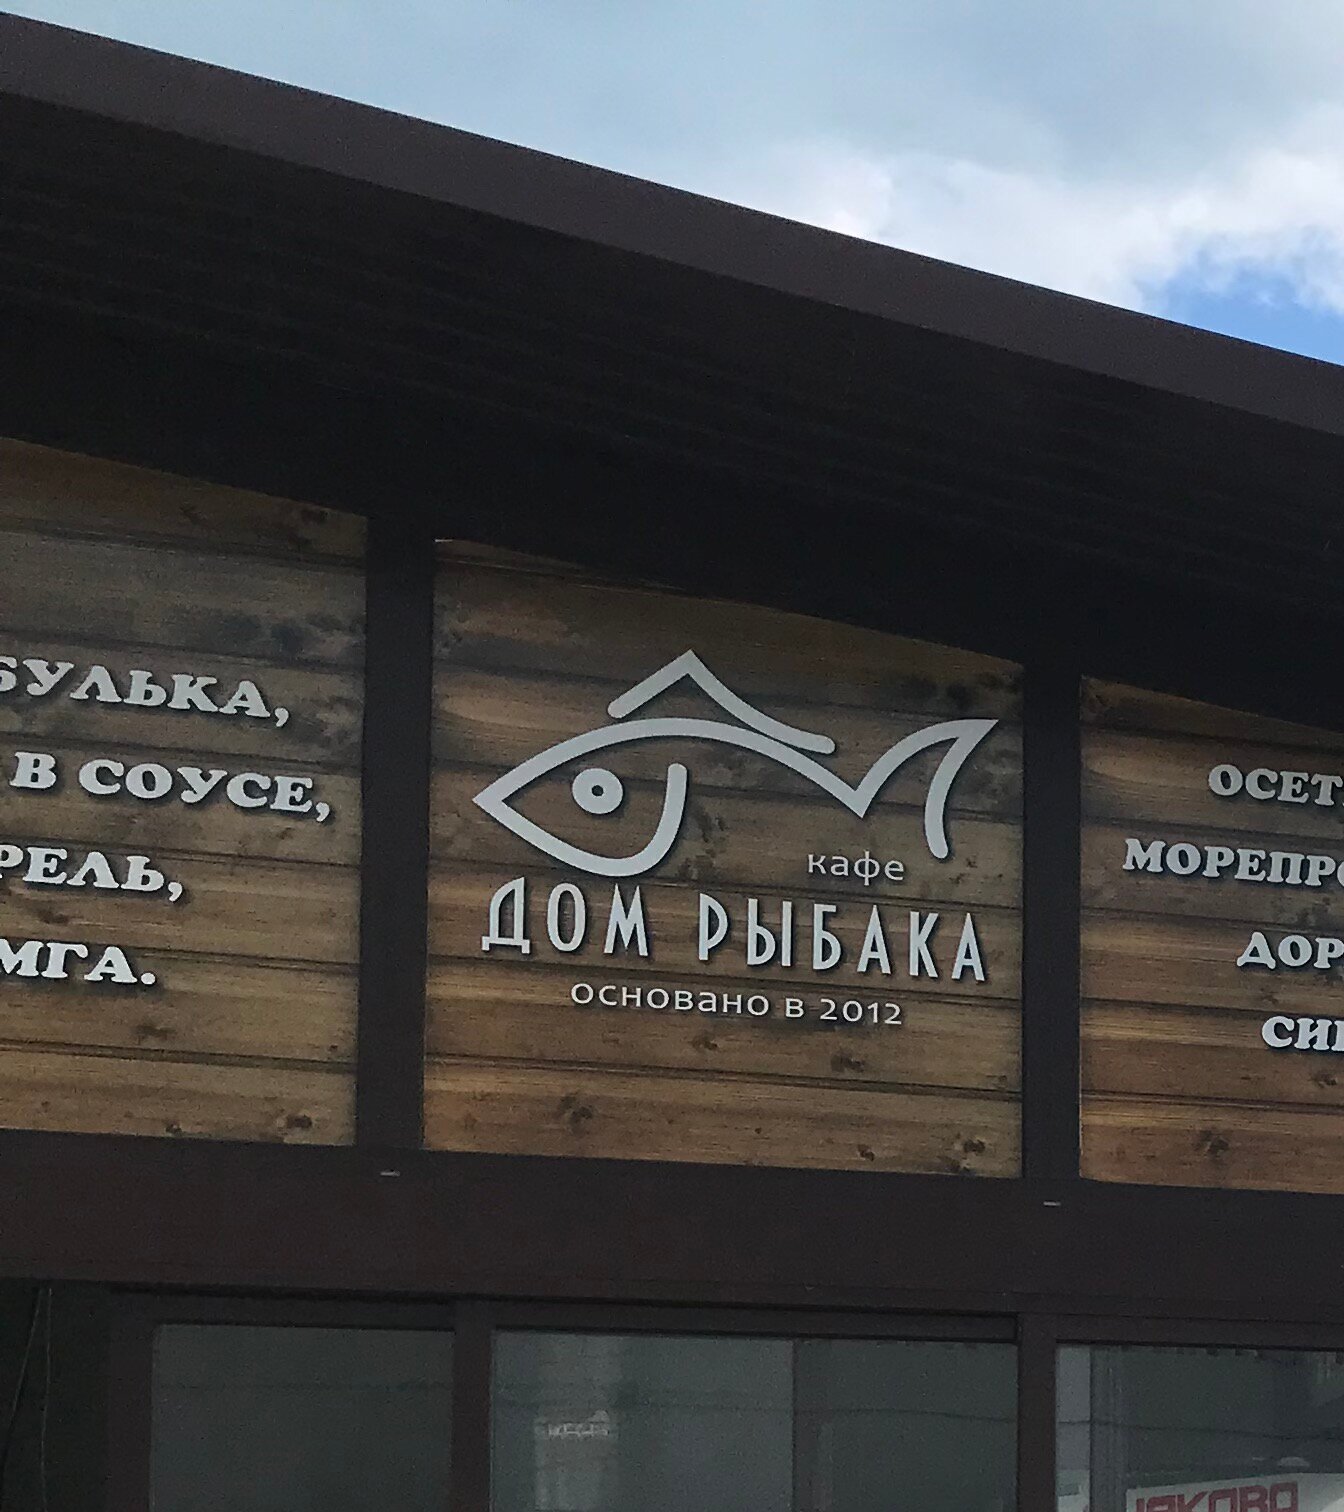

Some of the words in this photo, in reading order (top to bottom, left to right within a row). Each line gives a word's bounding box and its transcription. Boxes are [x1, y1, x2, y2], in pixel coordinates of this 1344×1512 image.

[9, 751, 58, 790] В
[78, 758, 331, 823] СОУСЕ,
[807, 850, 906, 887] кафе
[480, 875, 650, 958] ДОМ
[697, 892, 986, 983] РЫБАКА
[569, 982, 770, 1017] основано
[819, 998, 904, 1026] 2012
